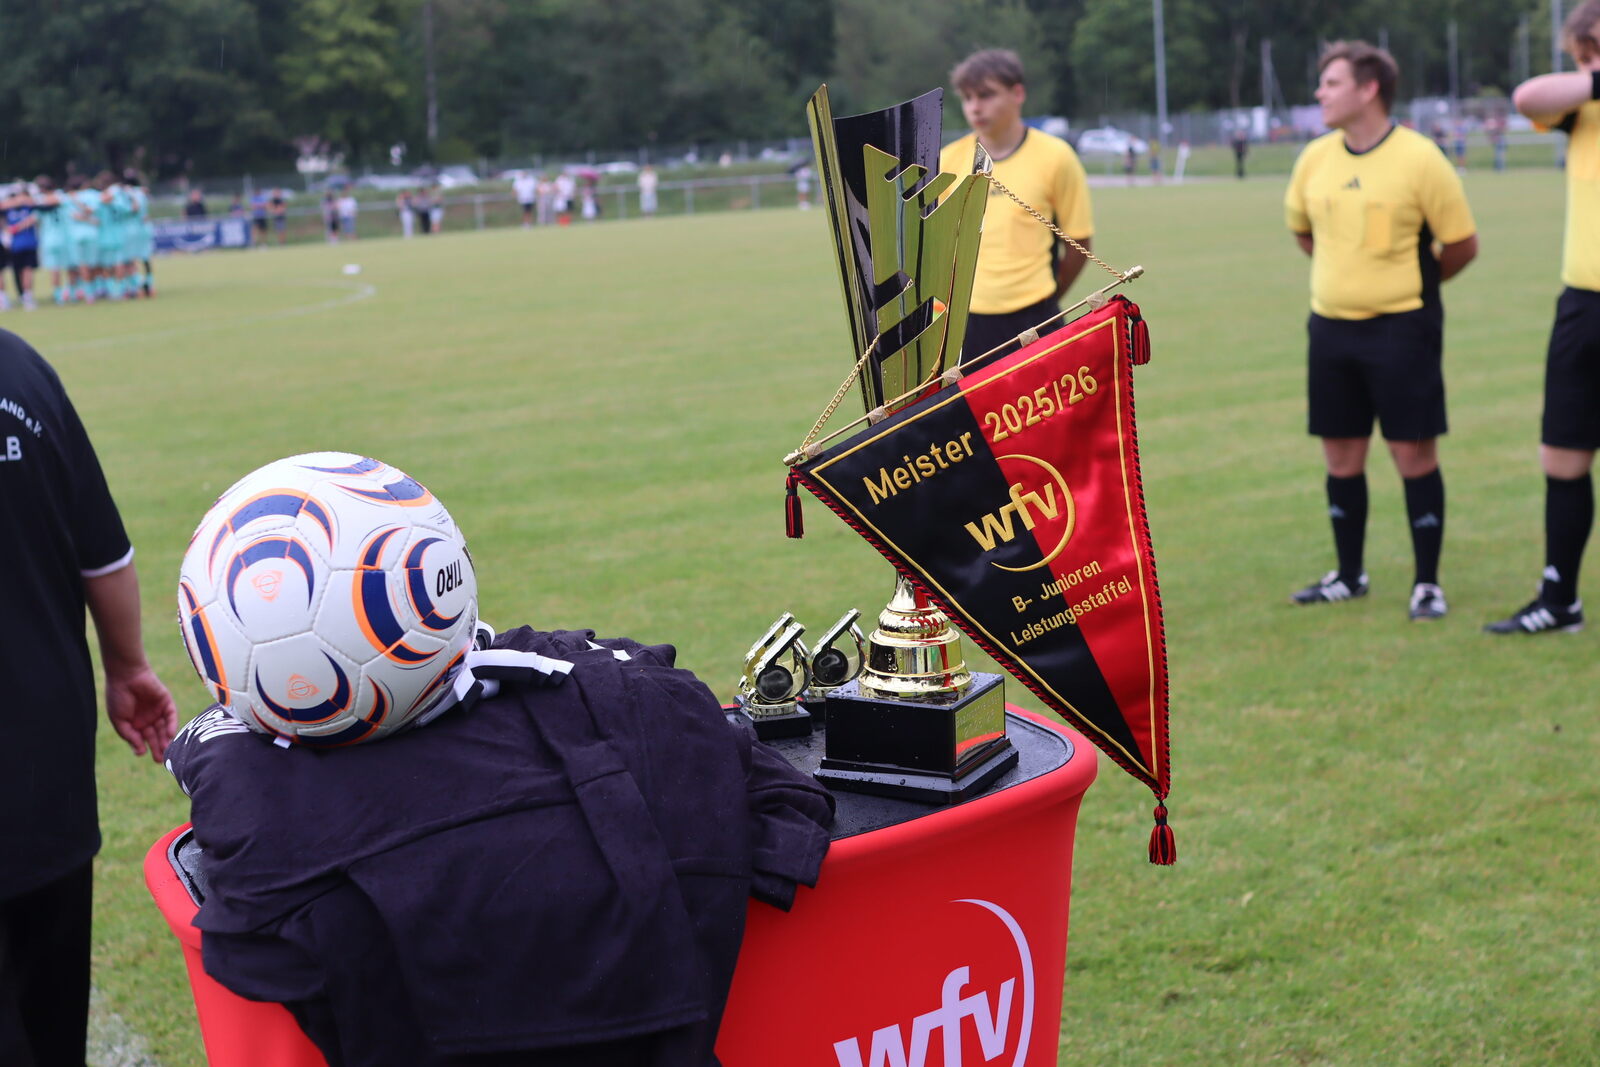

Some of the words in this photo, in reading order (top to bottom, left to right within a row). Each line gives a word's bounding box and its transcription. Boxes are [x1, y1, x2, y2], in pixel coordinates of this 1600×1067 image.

[984, 365, 1098, 443] 2025/26
[862, 431, 973, 505] Meister
[964, 482, 1058, 552] wfv
[436, 559, 463, 597] TIRO
[1011, 575, 1132, 646] Leistungsstaffel
[1040, 560, 1102, 601] Junioren
[833, 965, 1016, 1067] wfv
